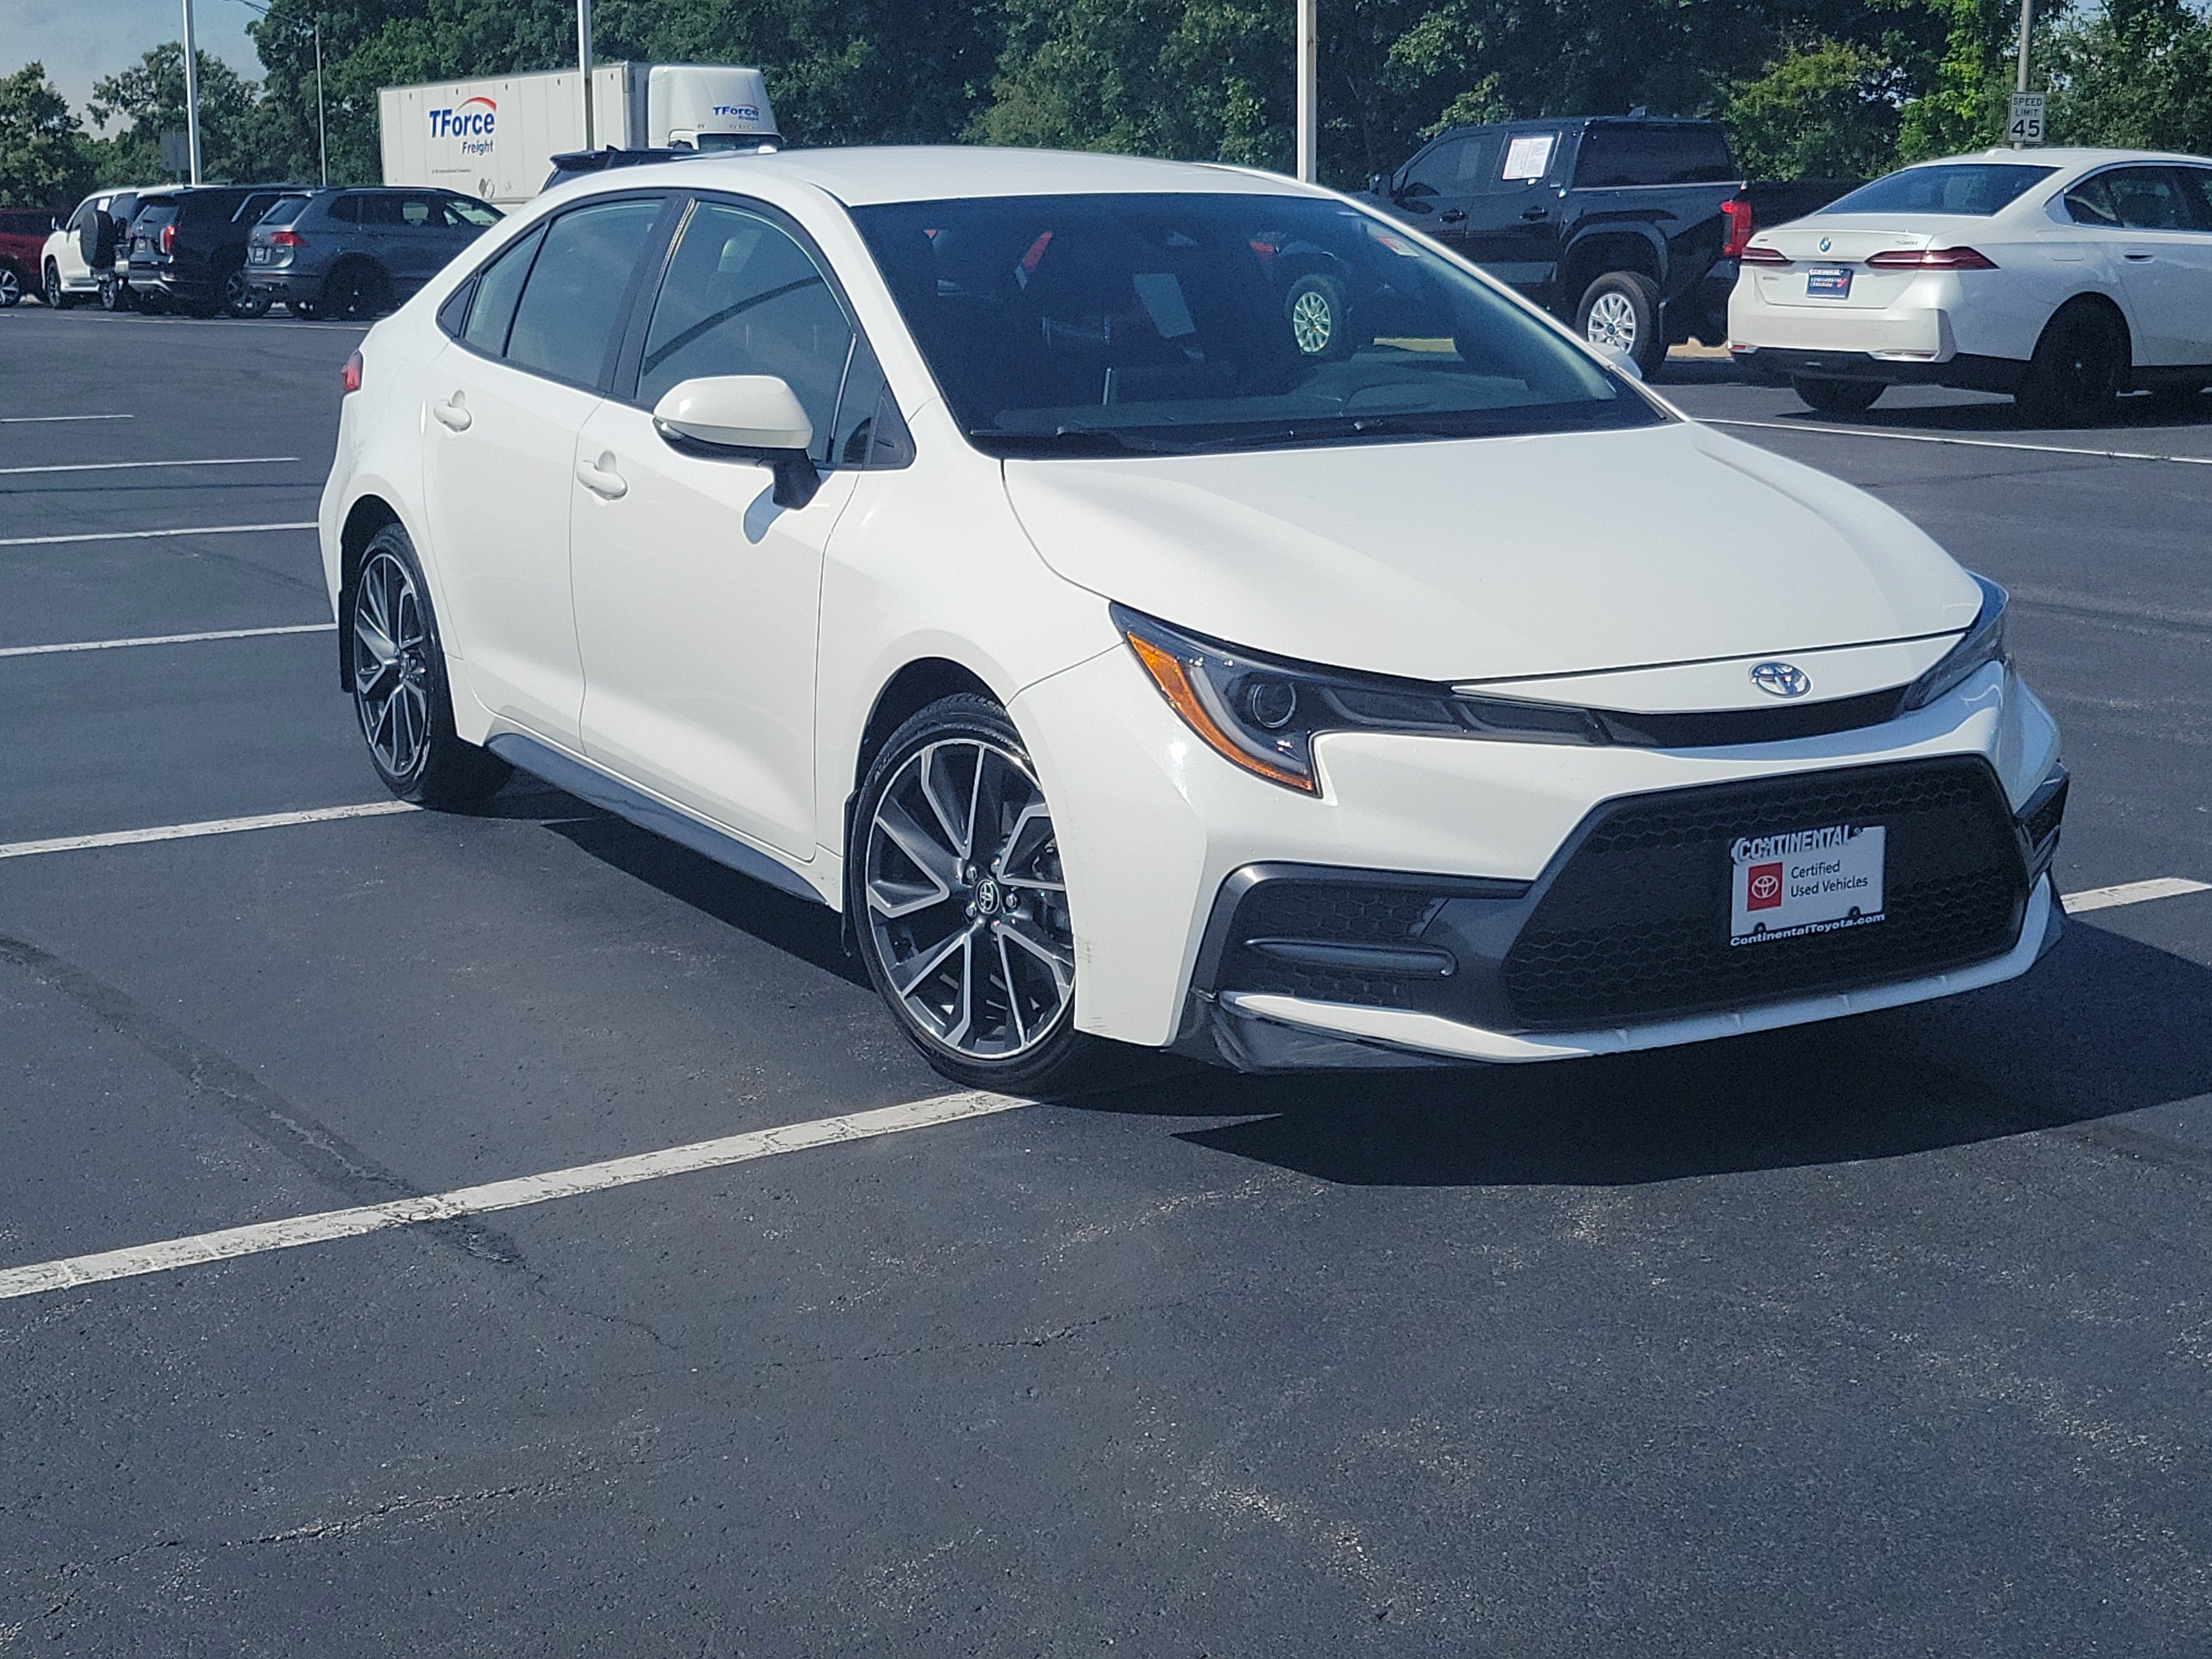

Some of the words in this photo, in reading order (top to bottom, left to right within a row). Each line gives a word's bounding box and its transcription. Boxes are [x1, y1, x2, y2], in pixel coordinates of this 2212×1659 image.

[713, 106, 759, 116] TForce
[2013, 98, 2042, 106] SPEED
[429, 109, 494, 138] TForce
[2011, 120, 2040, 137] 45
[462, 139, 493, 155] Freight
[1733, 824, 1853, 863] CONTINENTAL
[1791, 860, 1840, 879] Certified
[1791, 882, 1819, 898] Used
[1822, 876, 1869, 892] Vehicles
[1730, 914, 1885, 946] ContinentalToyota.com
